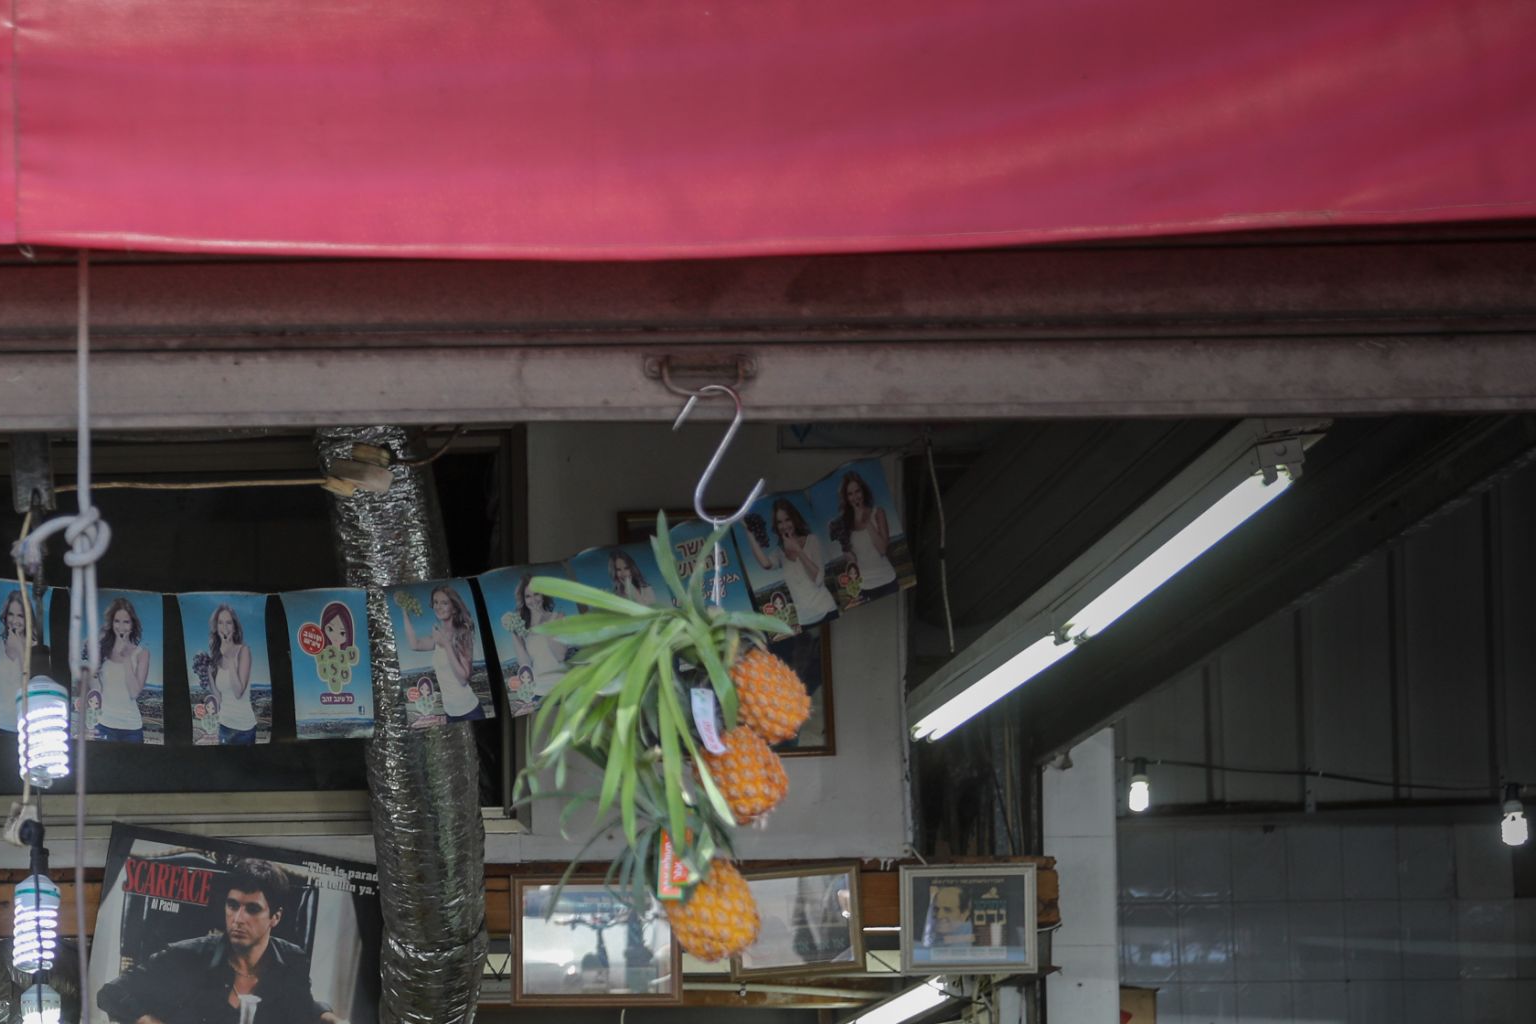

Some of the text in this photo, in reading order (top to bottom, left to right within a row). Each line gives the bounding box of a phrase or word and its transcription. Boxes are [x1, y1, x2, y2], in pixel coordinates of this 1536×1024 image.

[122, 859, 214, 905] SCARFACE
[335, 865, 346, 876] is
[348, 869, 379, 882] parad
[151, 898, 181, 914] Al Pacino
